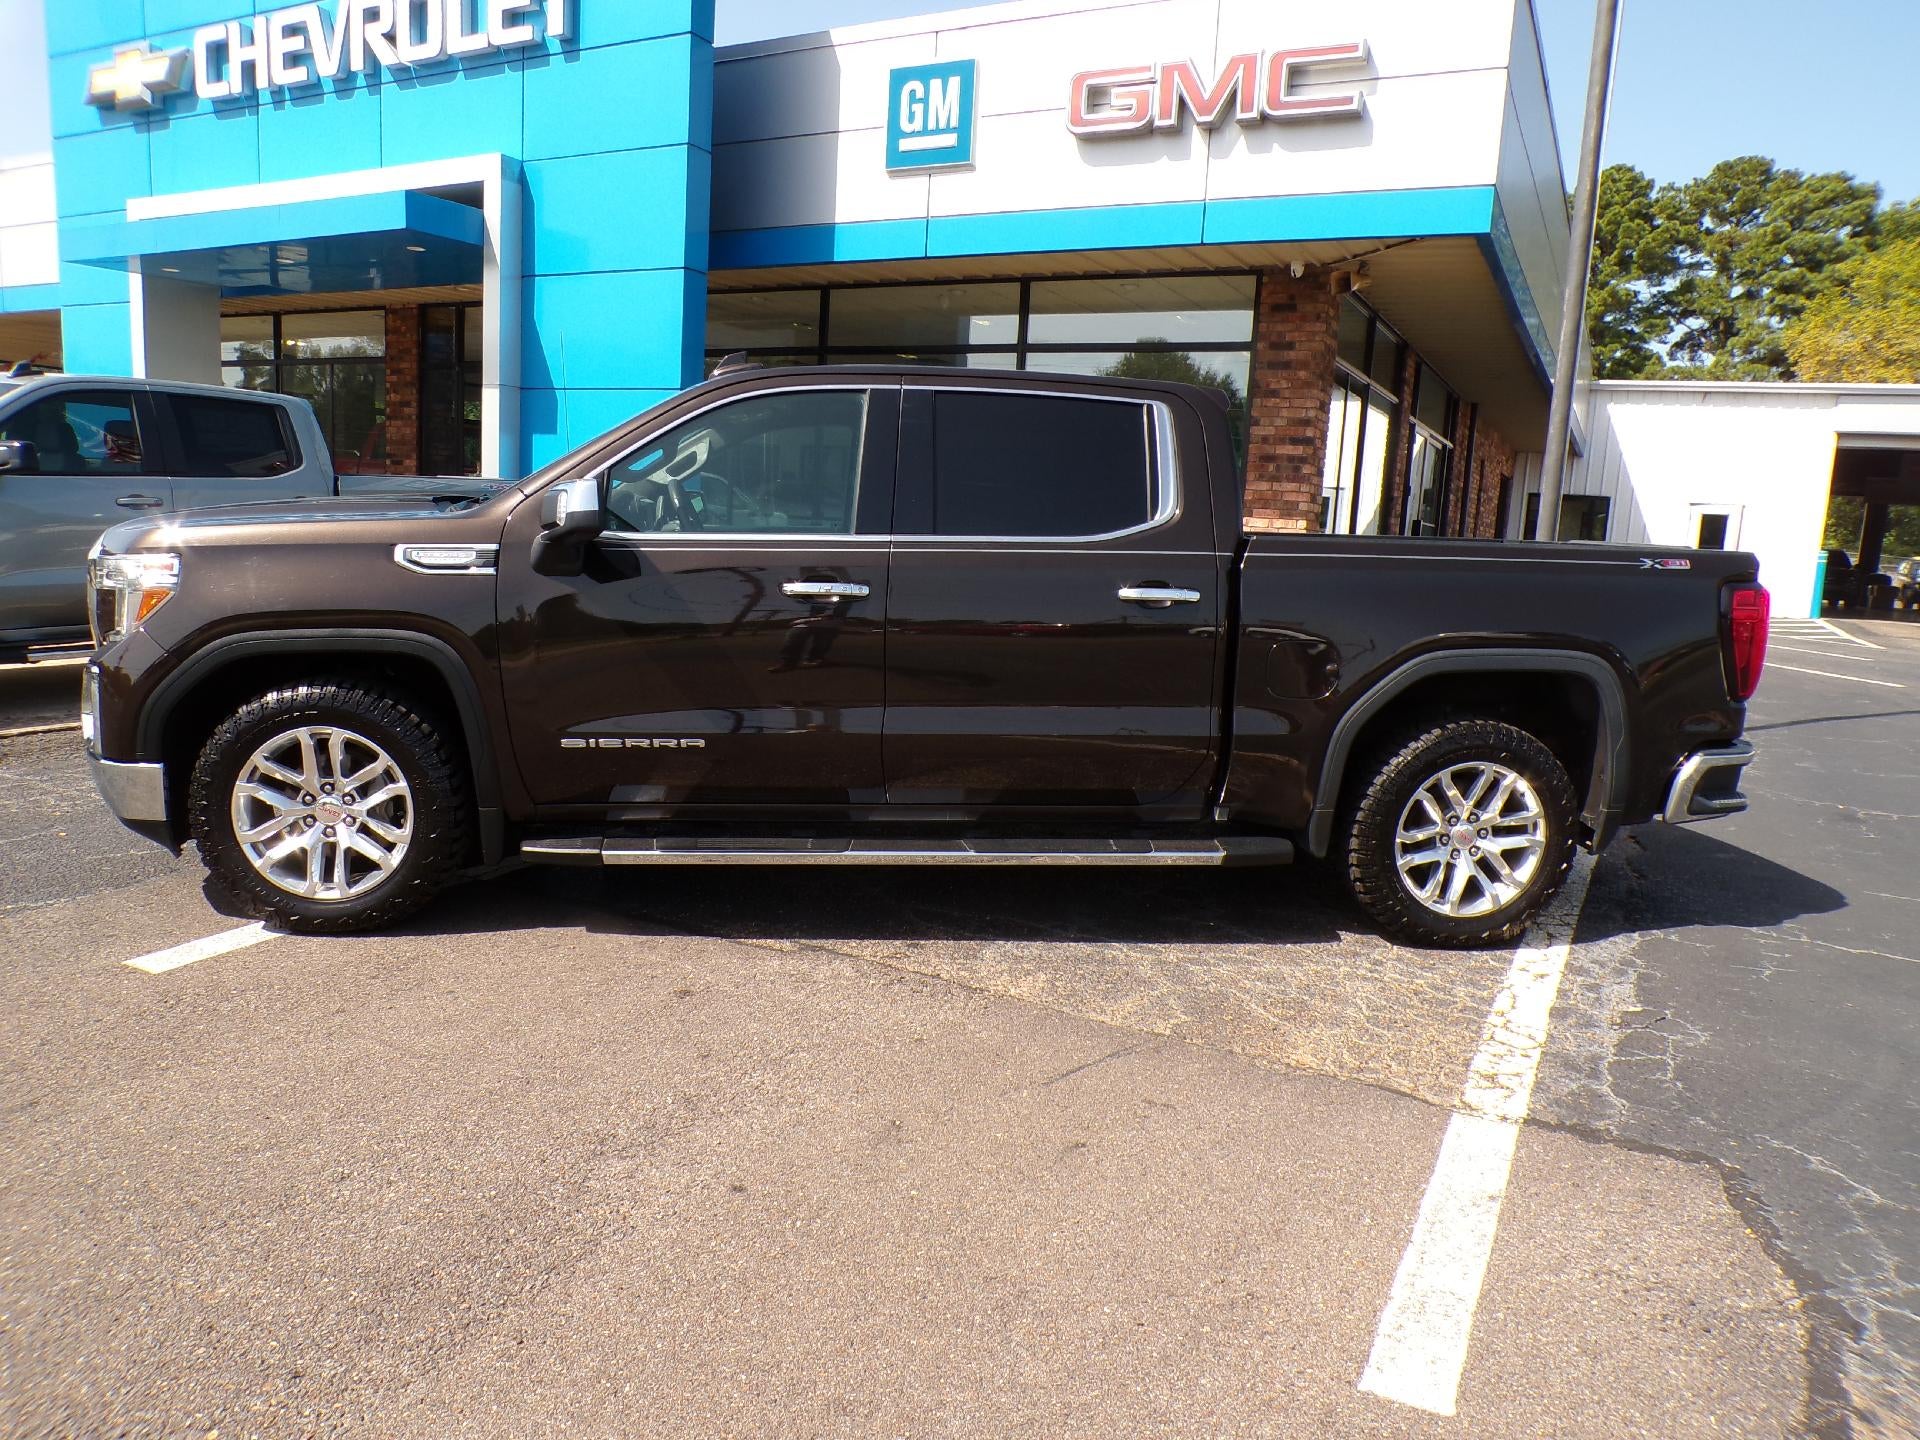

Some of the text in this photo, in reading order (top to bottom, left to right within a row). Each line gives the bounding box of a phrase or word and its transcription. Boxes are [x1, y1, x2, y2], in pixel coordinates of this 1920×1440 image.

[899, 75, 961, 134] GM
[1066, 40, 1370, 138] GMC
[560, 738, 706, 748] SIERRA
